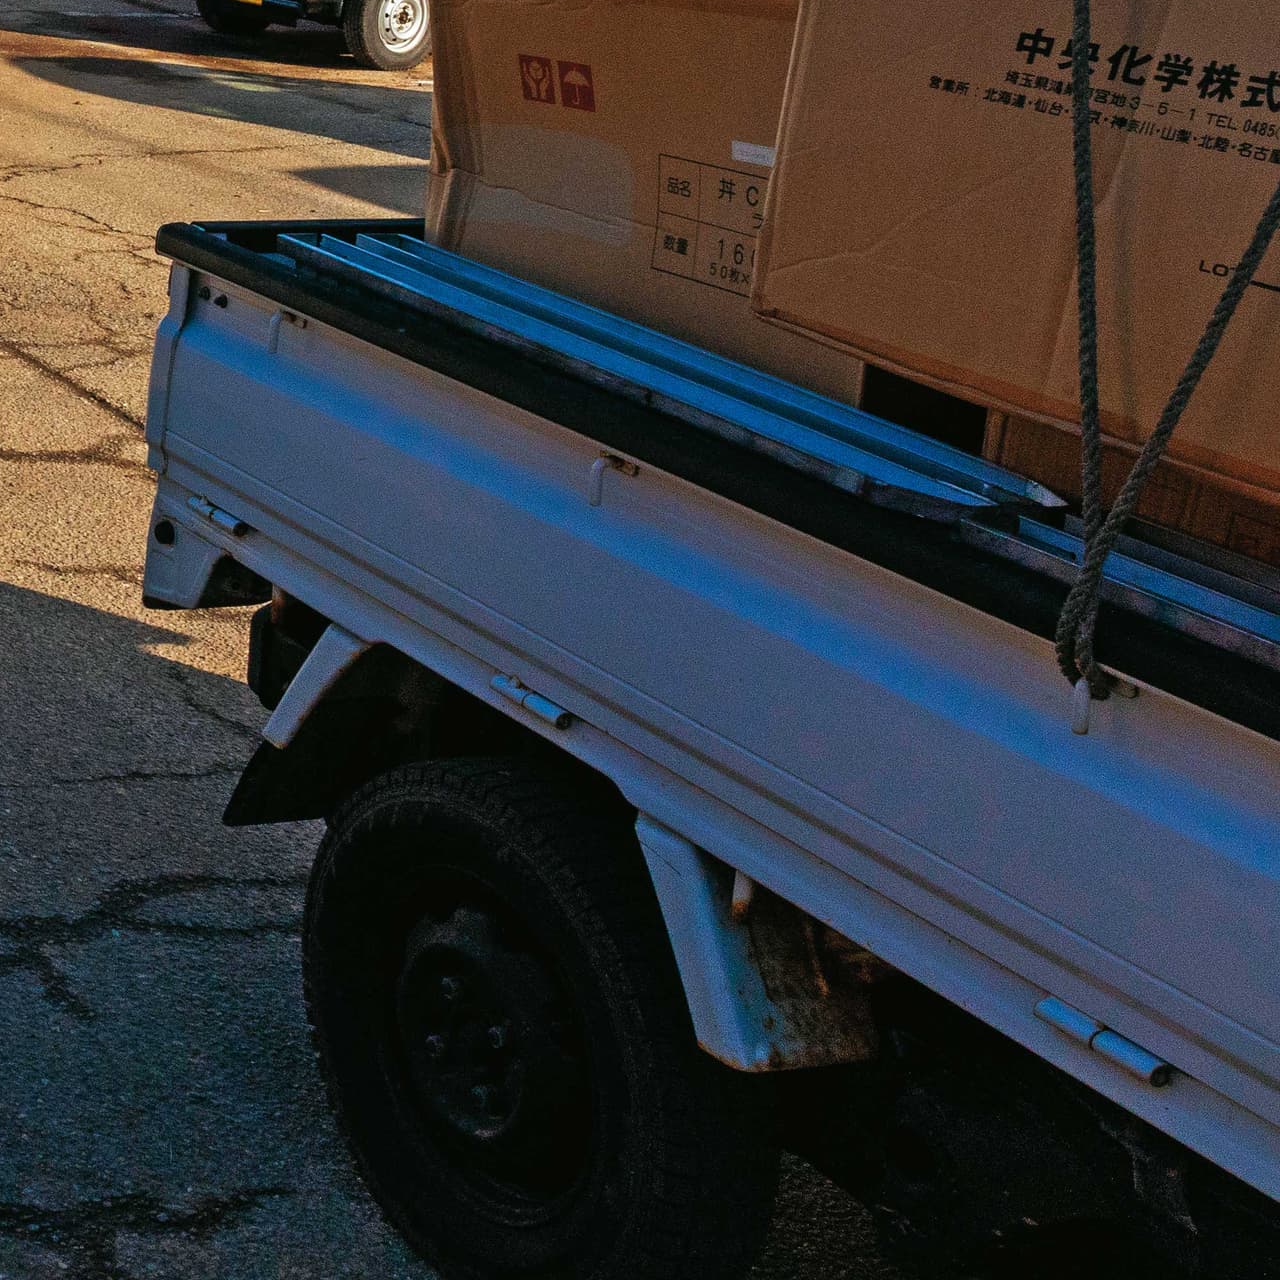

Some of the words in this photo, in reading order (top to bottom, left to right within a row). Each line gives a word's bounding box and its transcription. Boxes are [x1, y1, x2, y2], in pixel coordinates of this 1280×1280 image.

[1206, 112, 1238, 131] TEL
[667, 176, 691, 198] 品名
[1199, 260, 1237, 277] LO
